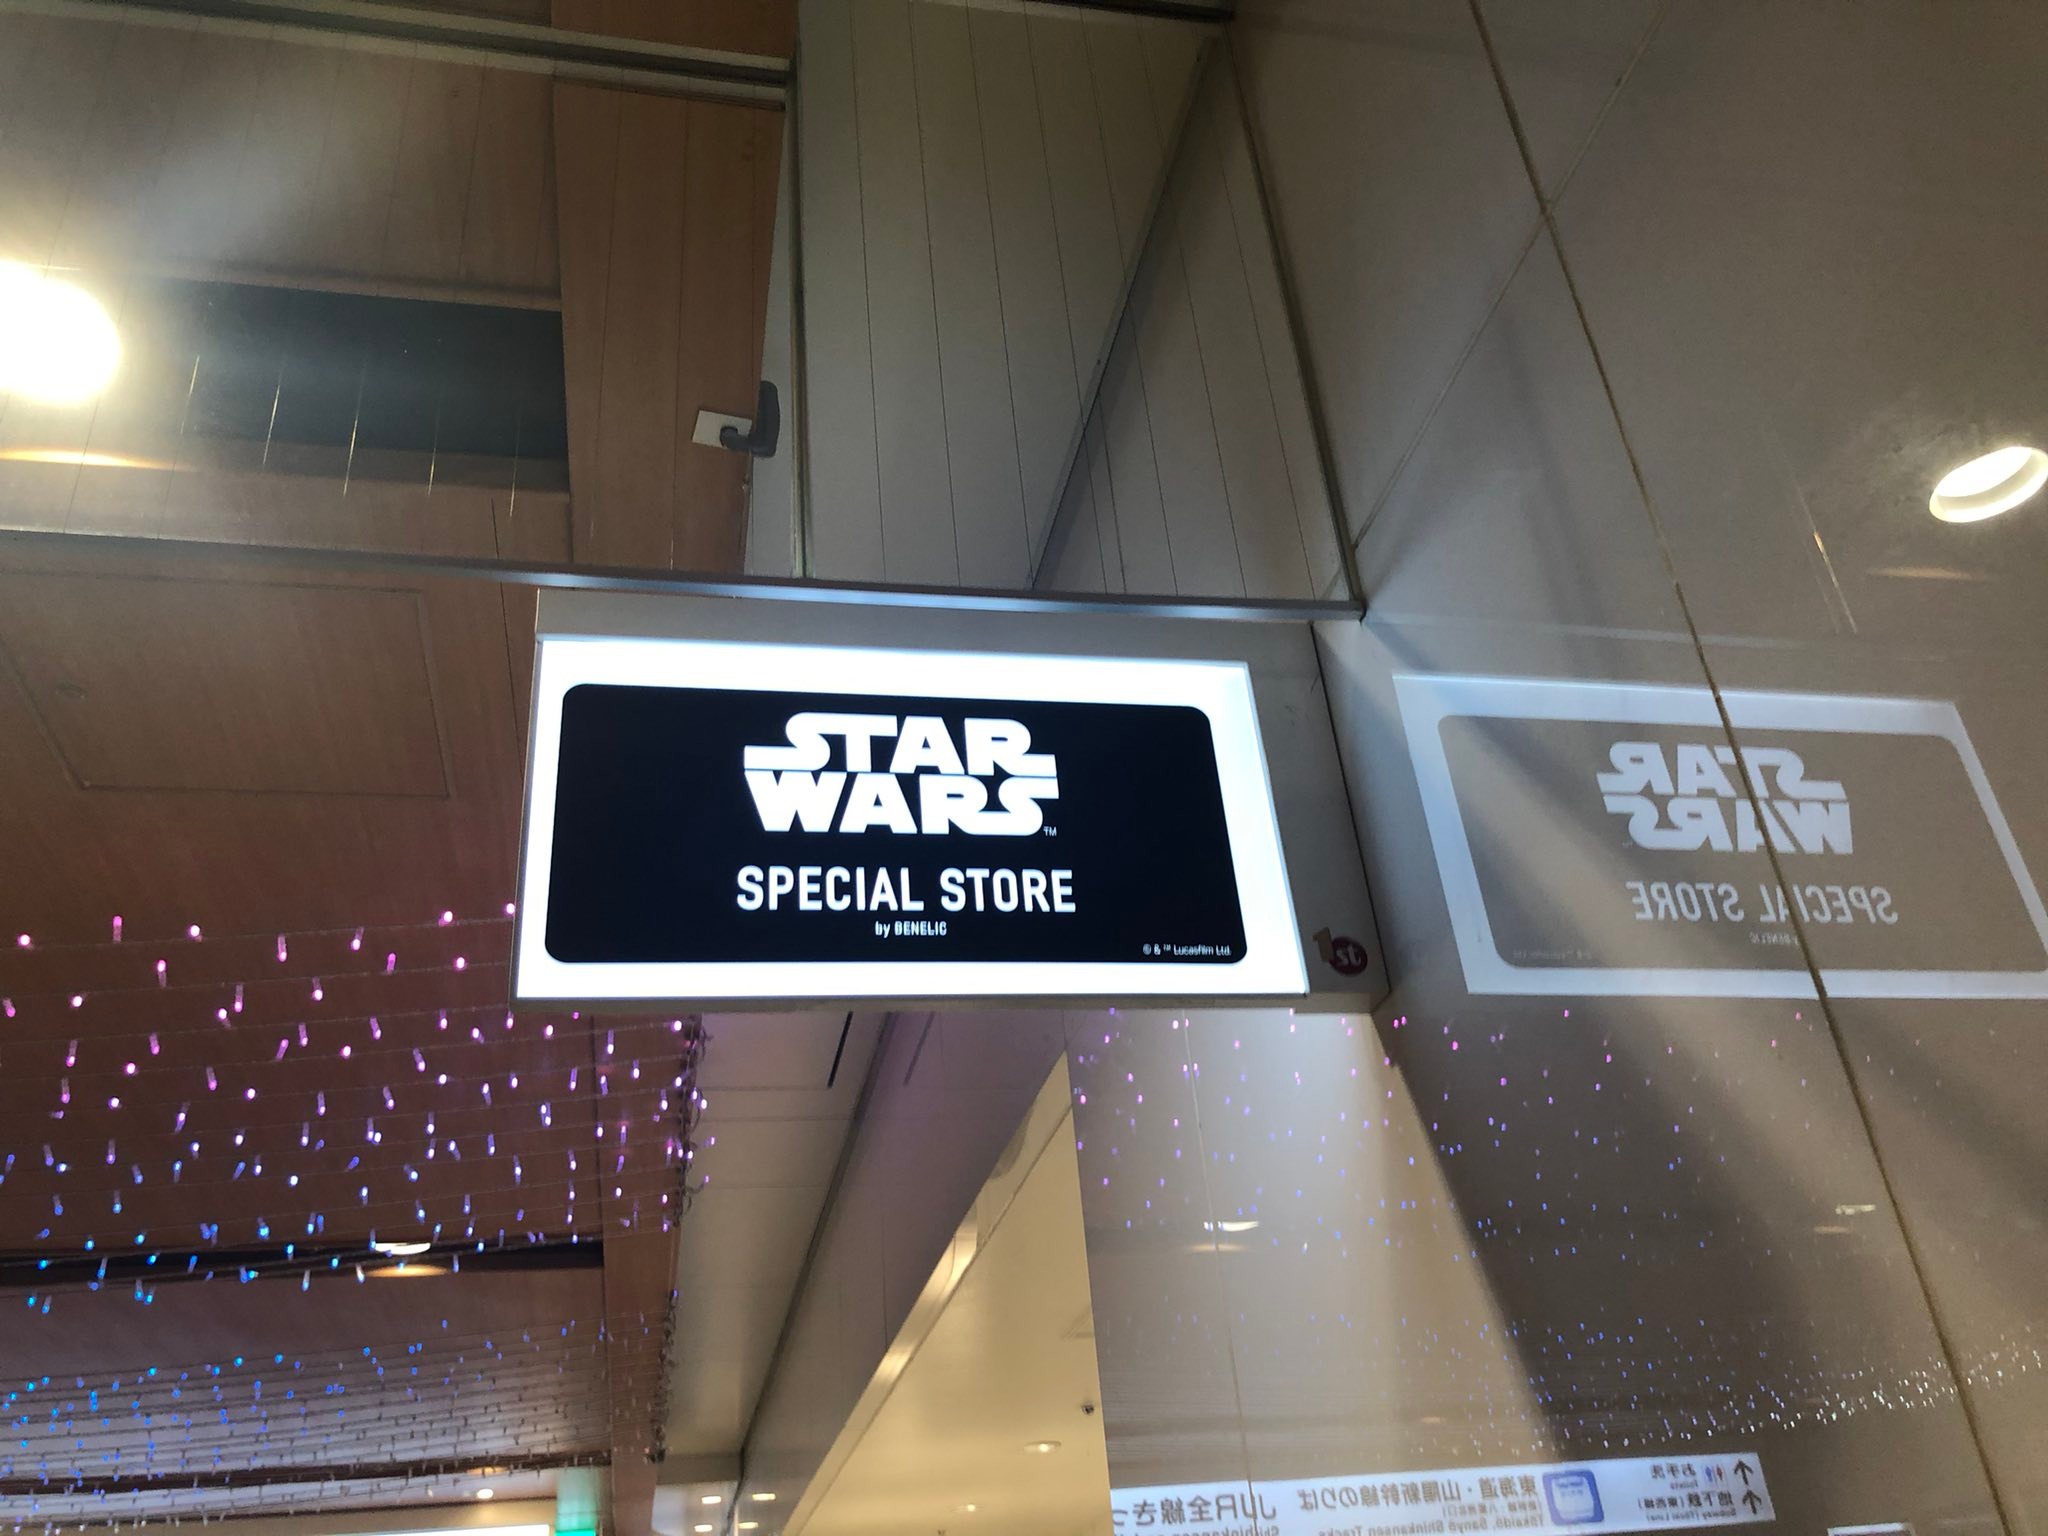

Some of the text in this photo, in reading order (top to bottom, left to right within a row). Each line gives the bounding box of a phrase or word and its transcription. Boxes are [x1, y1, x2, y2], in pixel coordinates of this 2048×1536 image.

[743, 712, 1057, 778] STAR
[743, 769, 1060, 838] WARS
[735, 864, 1077, 915] SPECIAL STORE
[874, 920, 948, 939] by BENELIC
